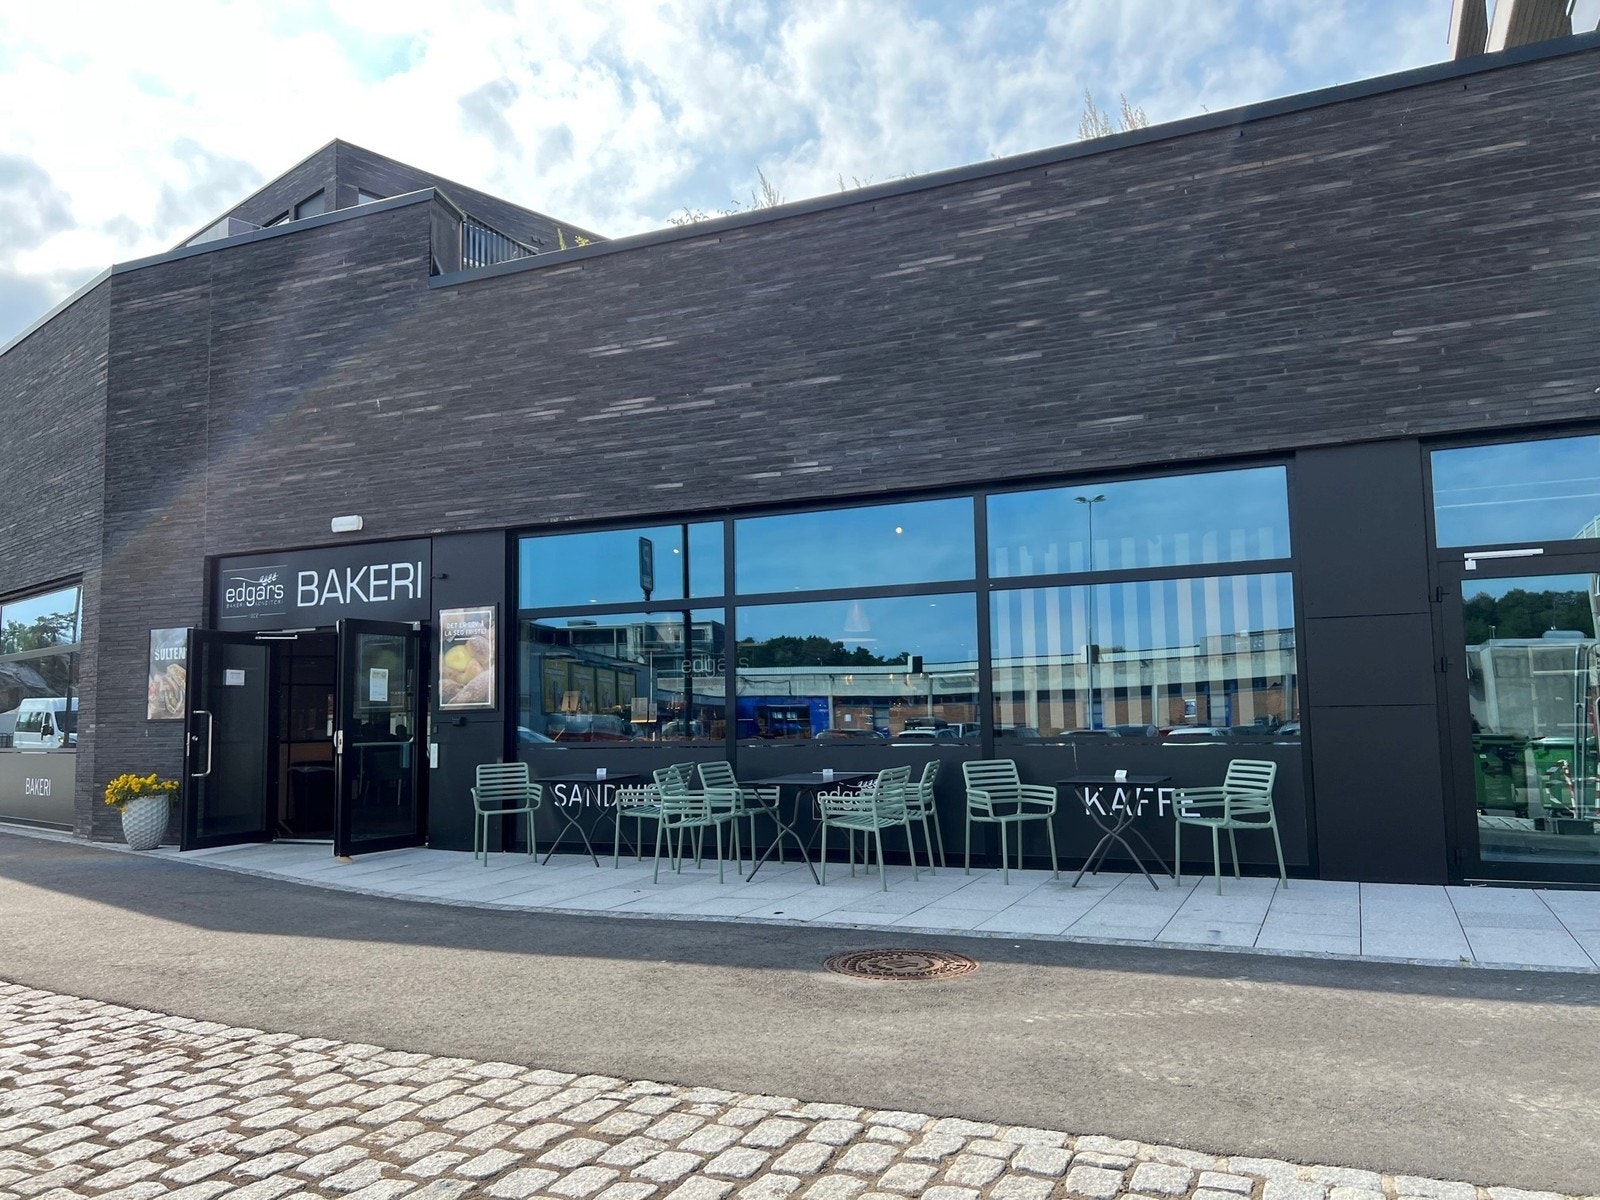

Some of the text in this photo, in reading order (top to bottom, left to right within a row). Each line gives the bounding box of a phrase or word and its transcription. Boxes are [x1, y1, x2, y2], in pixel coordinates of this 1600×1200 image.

[226, 582, 284, 607] edgars
[297, 561, 422, 607] BAKERI
[154, 646, 187, 660] SULTEN
[681, 653, 749, 677] edgas
[25, 777, 51, 796] BAKERI
[554, 784, 664, 807] SANDWI
[1084, 787, 1201, 817] KAFFE
